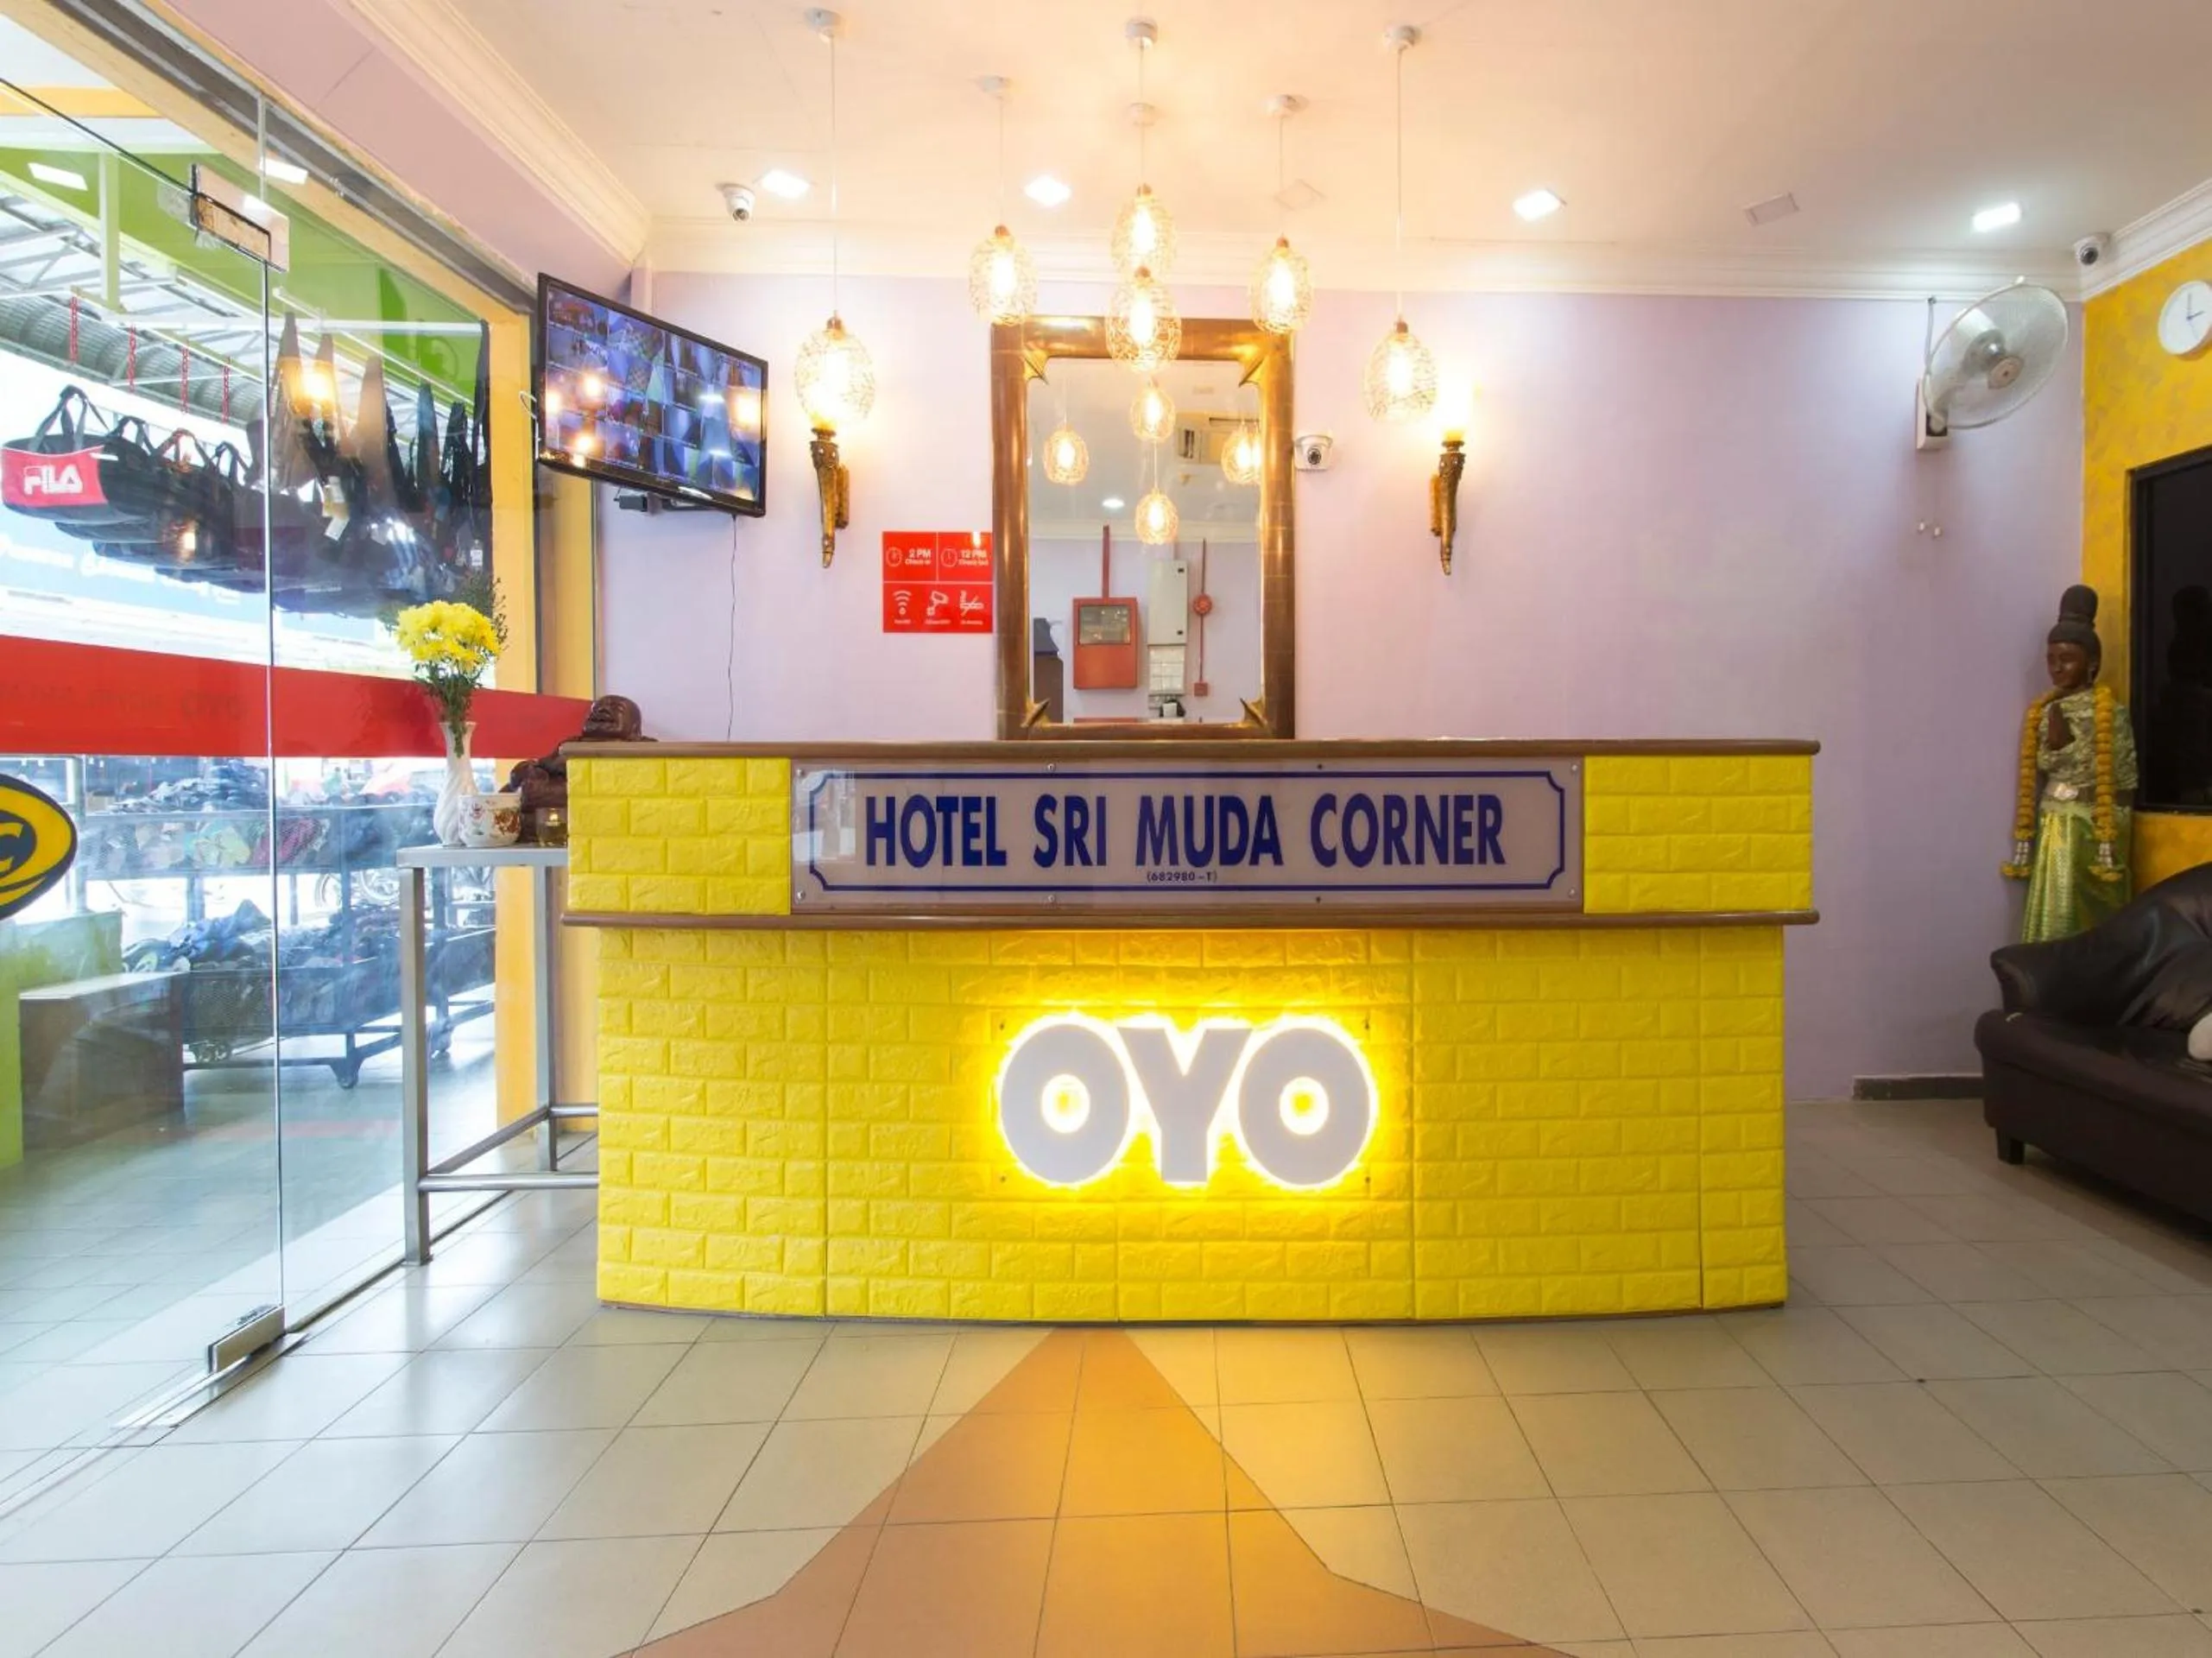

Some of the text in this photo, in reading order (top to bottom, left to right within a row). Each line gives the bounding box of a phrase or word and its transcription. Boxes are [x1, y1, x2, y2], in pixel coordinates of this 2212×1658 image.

[23, 464, 84, 496] FILA
[916, 547, 932, 559] PM
[866, 793, 1506, 869] HOTEL SRI MUDA CORNER
[1000, 1022, 1370, 1186] OYO
